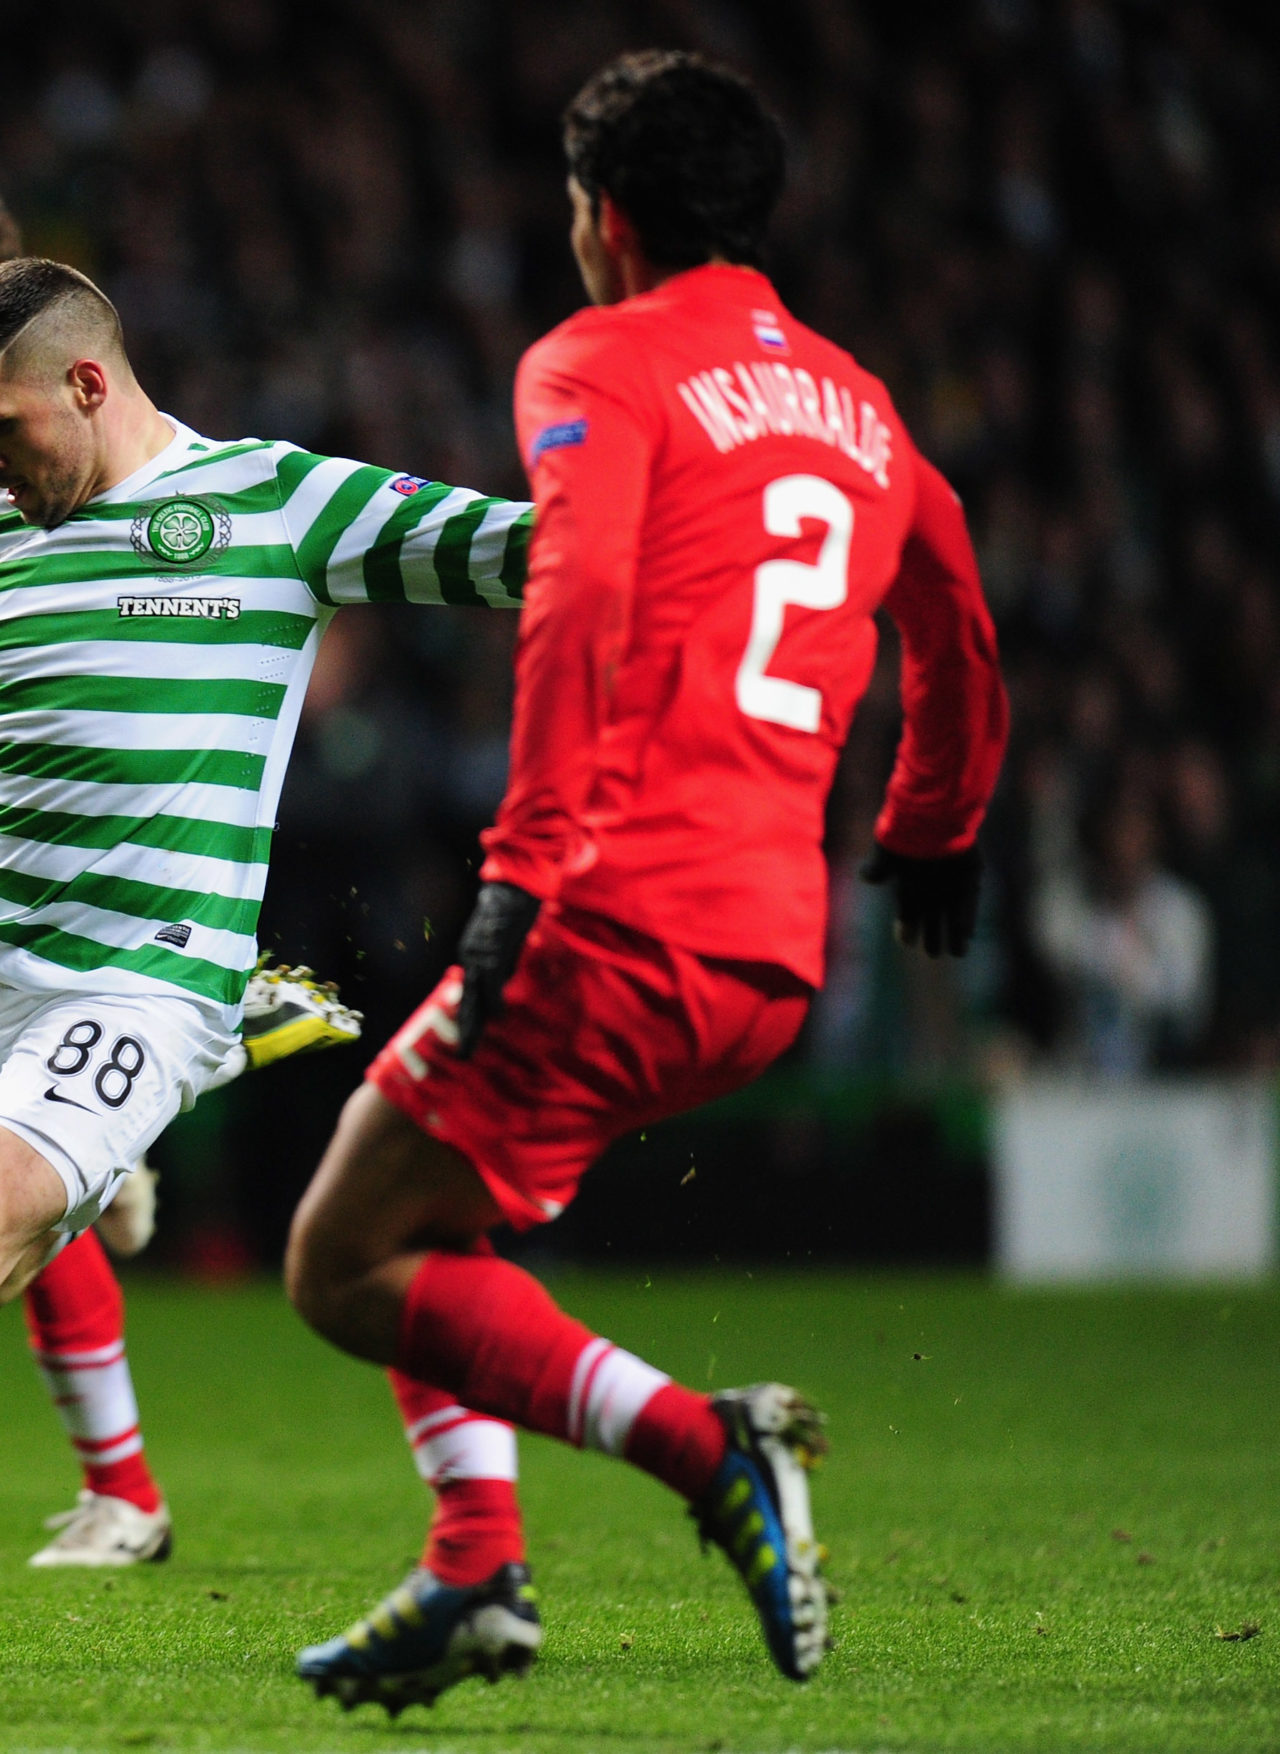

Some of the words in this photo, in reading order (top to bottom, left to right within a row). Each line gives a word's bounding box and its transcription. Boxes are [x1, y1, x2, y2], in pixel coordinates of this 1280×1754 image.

[677, 361, 892, 489] INSAURRALDE
[156, 505, 175, 522] CELTIC
[118, 597, 240, 619] TENNENT'S
[735, 473, 854, 733] 2
[47, 1020, 145, 1108] 88
